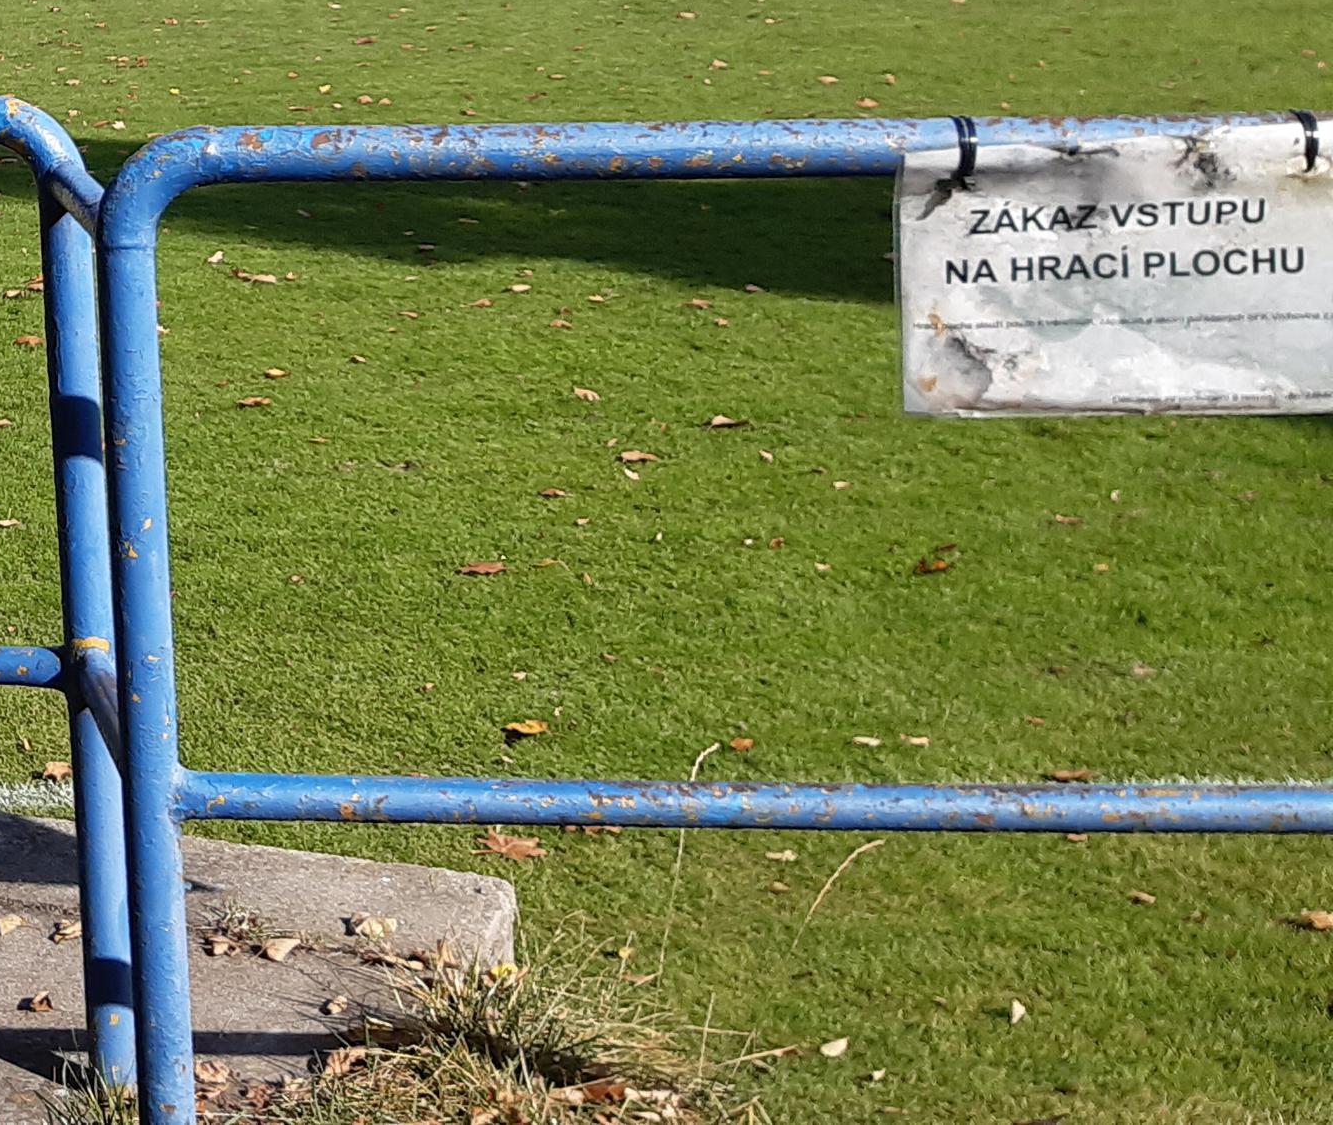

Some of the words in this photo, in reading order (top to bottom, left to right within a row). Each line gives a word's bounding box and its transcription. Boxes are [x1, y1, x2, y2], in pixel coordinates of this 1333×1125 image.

[968, 200, 1099, 236] ZÁKAZ
[1109, 197, 1268, 228] VSTUPU
[944, 258, 997, 285] NA
[1010, 244, 1130, 281] HRACÍ
[1142, 245, 1306, 279] PLOCHU
